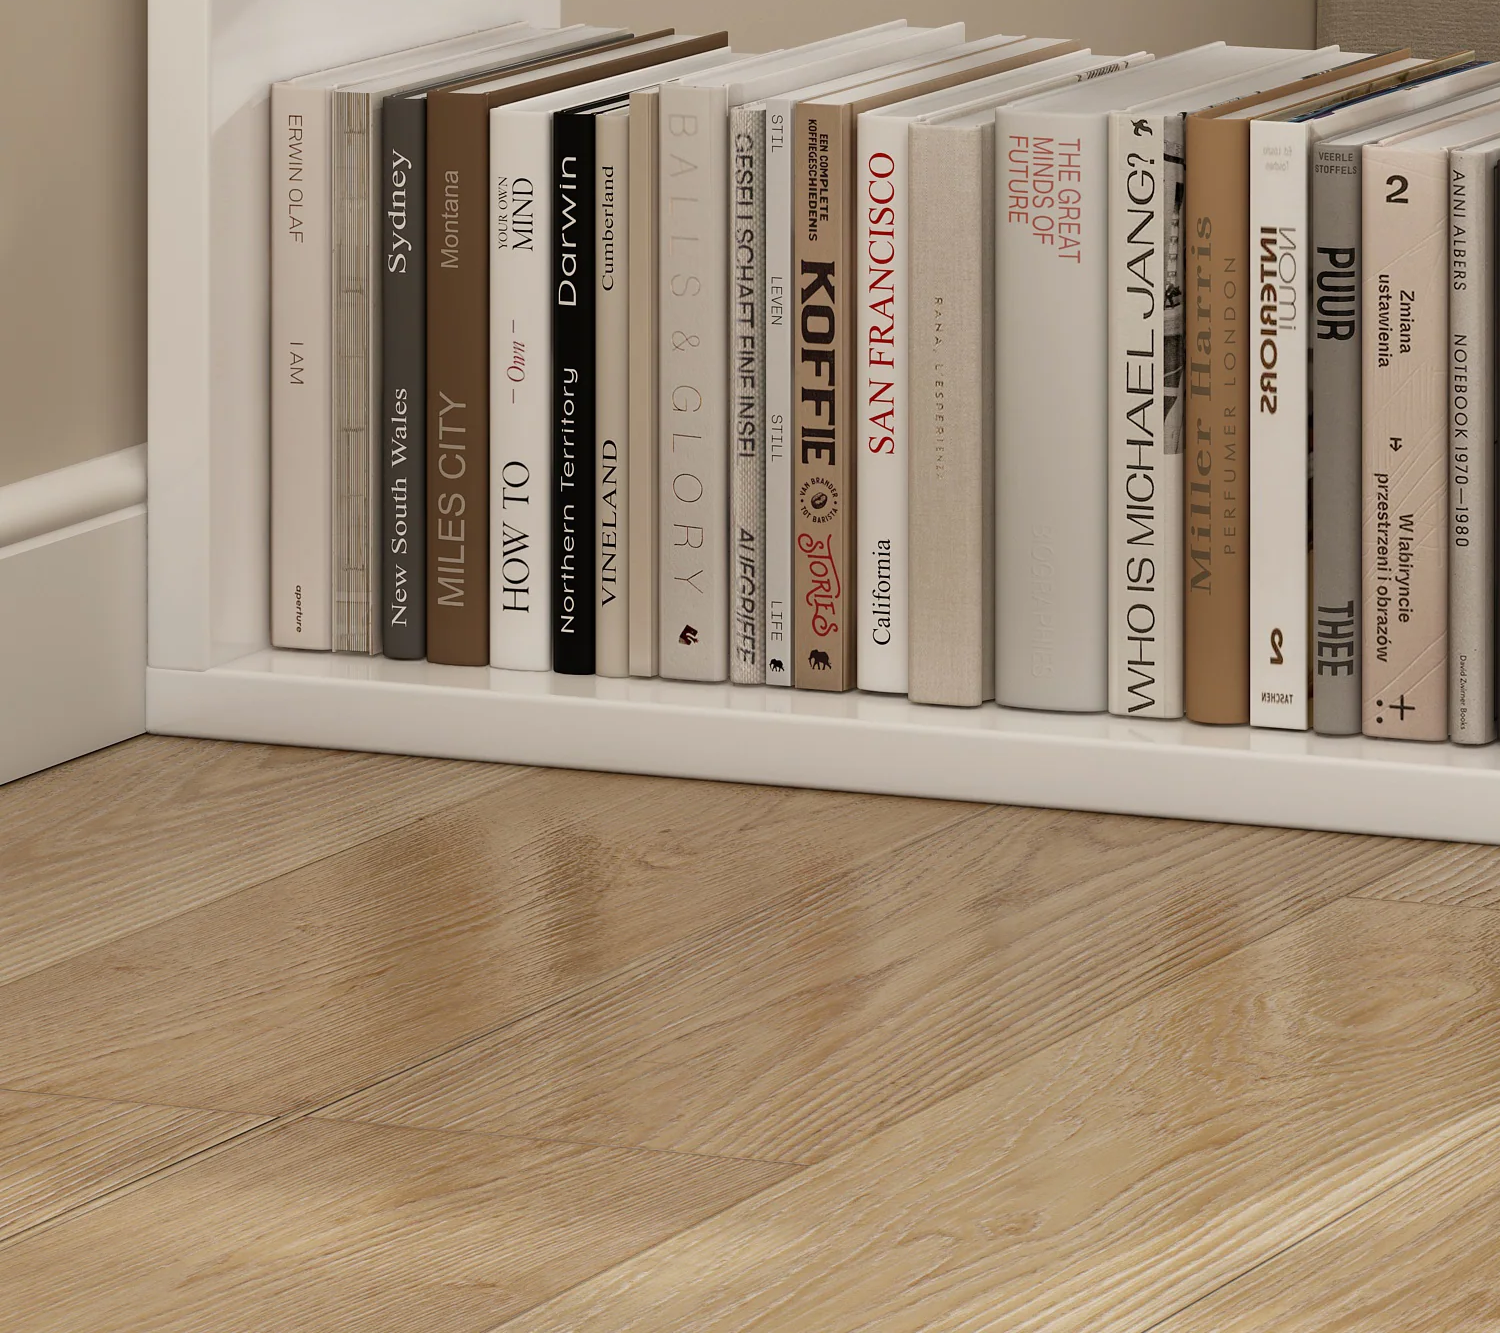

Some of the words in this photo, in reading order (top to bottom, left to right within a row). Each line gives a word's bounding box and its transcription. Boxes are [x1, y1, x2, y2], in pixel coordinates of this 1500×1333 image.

[289, 115, 302, 181] ERWIN
[772, 115, 783, 152] STIL
[820, 134, 828, 151] EEN
[1059, 139, 1080, 182] THE
[1314, 165, 1358, 174] STOFFELS
[1319, 152, 1353, 161] VEERLE
[499, 178, 507, 209] OWN
[809, 119, 817, 241] KOFFIEGESCHIEDENIS
[820, 156, 828, 221] COMPLETE
[1008, 136, 1028, 223] FUTURE
[1032, 138, 1054, 208] MINDS
[1453, 170, 1465, 217] ANNI
[289, 189, 303, 243] OLAF
[388, 149, 411, 273] Sydney
[441, 171, 458, 268] Montana
[499, 215, 507, 249] YOUR
[512, 178, 533, 251] MIND
[559, 157, 576, 306] Darwin
[602, 167, 613, 290] Cumberland
[1032, 216, 1054, 245] OF
[1058, 189, 1081, 263] GREAT
[1127, 153, 1155, 319] JANG?
[869, 153, 894, 369] FRANCISCO
[1317, 247, 1355, 341] PUUR
[1454, 225, 1466, 290] ALBERS
[771, 277, 782, 325] LEVEN
[1379, 275, 1393, 367] ustawienia
[1400, 290, 1414, 353] Zmiana
[290, 352, 304, 384] AM
[801, 260, 835, 465] KOFFIE
[1454, 335, 1467, 438] NOTEBOOK
[391, 389, 407, 467] Wales
[439, 391, 466, 479] CITY
[561, 368, 578, 492] Territory
[772, 415, 782, 461] STILL
[869, 378, 894, 454] SAN
[1126, 329, 1154, 545] MICHAEL
[391, 478, 407, 553] South
[503, 462, 529, 509] TO
[1374, 474, 1391, 571] przestrzeni
[1399, 514, 1413, 532] W
[438, 494, 465, 606] MILES
[602, 440, 617, 607] VINELAND
[392, 564, 407, 626] New
[503, 521, 529, 612] HOW
[561, 505, 574, 633] Northern
[872, 539, 890, 645] California
[1127, 558, 1155, 591] IS
[1395, 537, 1413, 622] labiryncie
[295, 585, 303, 632] aperture
[771, 601, 782, 641] LIFE
[1318, 600, 1354, 677] THEE
[1377, 586, 1391, 662] obrazów
[1127, 604, 1155, 713] WHO
